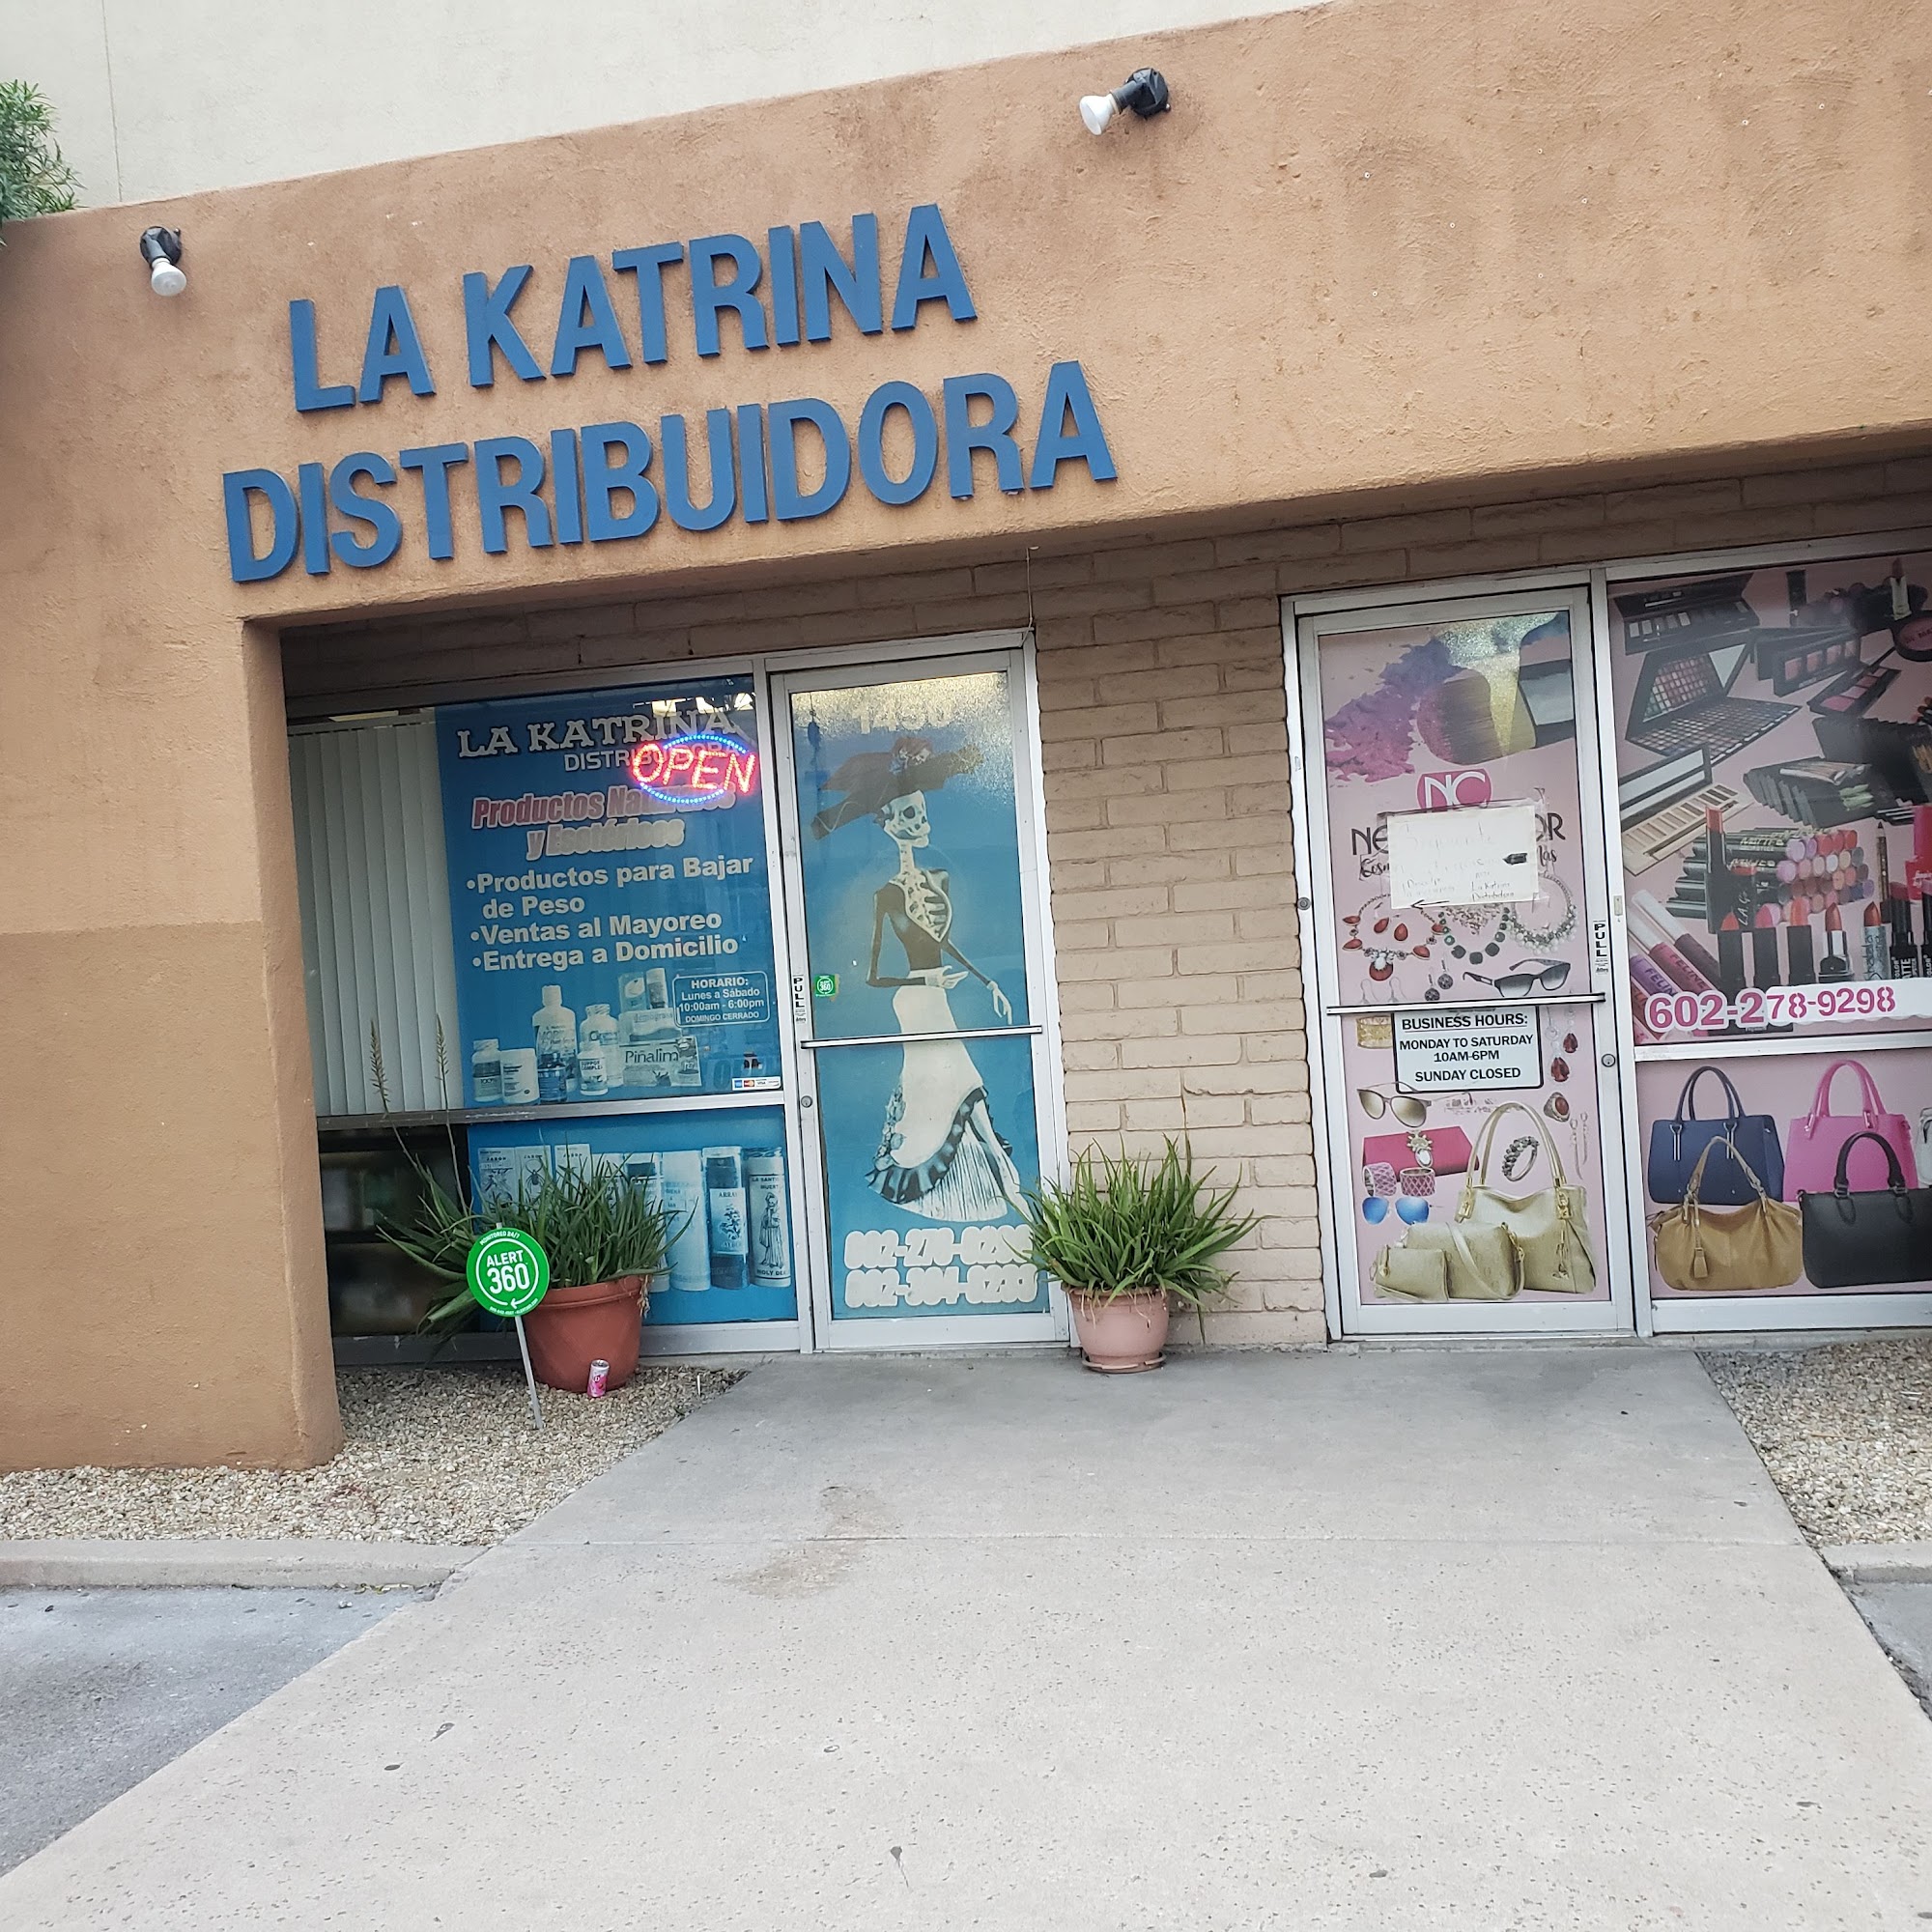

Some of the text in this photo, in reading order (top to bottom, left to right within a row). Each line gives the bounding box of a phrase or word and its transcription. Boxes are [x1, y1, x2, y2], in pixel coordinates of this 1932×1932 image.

[289, 203, 978, 413] LA KATRINA
[222, 359, 1118, 583] DISTRIBUIDORA
[457, 709, 740, 758] LA KATRINA
[632, 742, 755, 794] OPEN
[1424, 771, 1486, 810] NC
[472, 792, 605, 829] Productos
[526, 830, 545, 861] y
[477, 856, 753, 893] Productos para Bajar
[483, 895, 585, 919] de Peso
[480, 912, 723, 946] Ventas al Mayoreo
[1593, 923, 1607, 957] PULL
[483, 934, 739, 972] Entrega a Domicilio
[681, 991, 712, 1001] Lunes
[723, 987, 760, 999] Sábado
[691, 977, 749, 989] HORARIO:
[793, 977, 806, 1008] PULL
[1645, 967, 1678, 997] FELIN
[679, 1002, 720, 1012] 10:00am
[727, 999, 764, 1010] 6:00pm
[685, 1013, 721, 1023] DOMINGO
[723, 1011, 759, 1021] CERRADO
[1402, 1012, 1528, 1030] BUSINESS HOURS:
[1648, 986, 1896, 1029] 602-278-9298
[1400, 1034, 1533, 1050] MONDAY TO SATURDAY
[1434, 1050, 1499, 1062] 10AM-6PM
[1415, 1067, 1520, 1082] SUNDAY CLOSED
[486, 1249, 524, 1267] ALERT
[487, 1263, 530, 1294] 360
